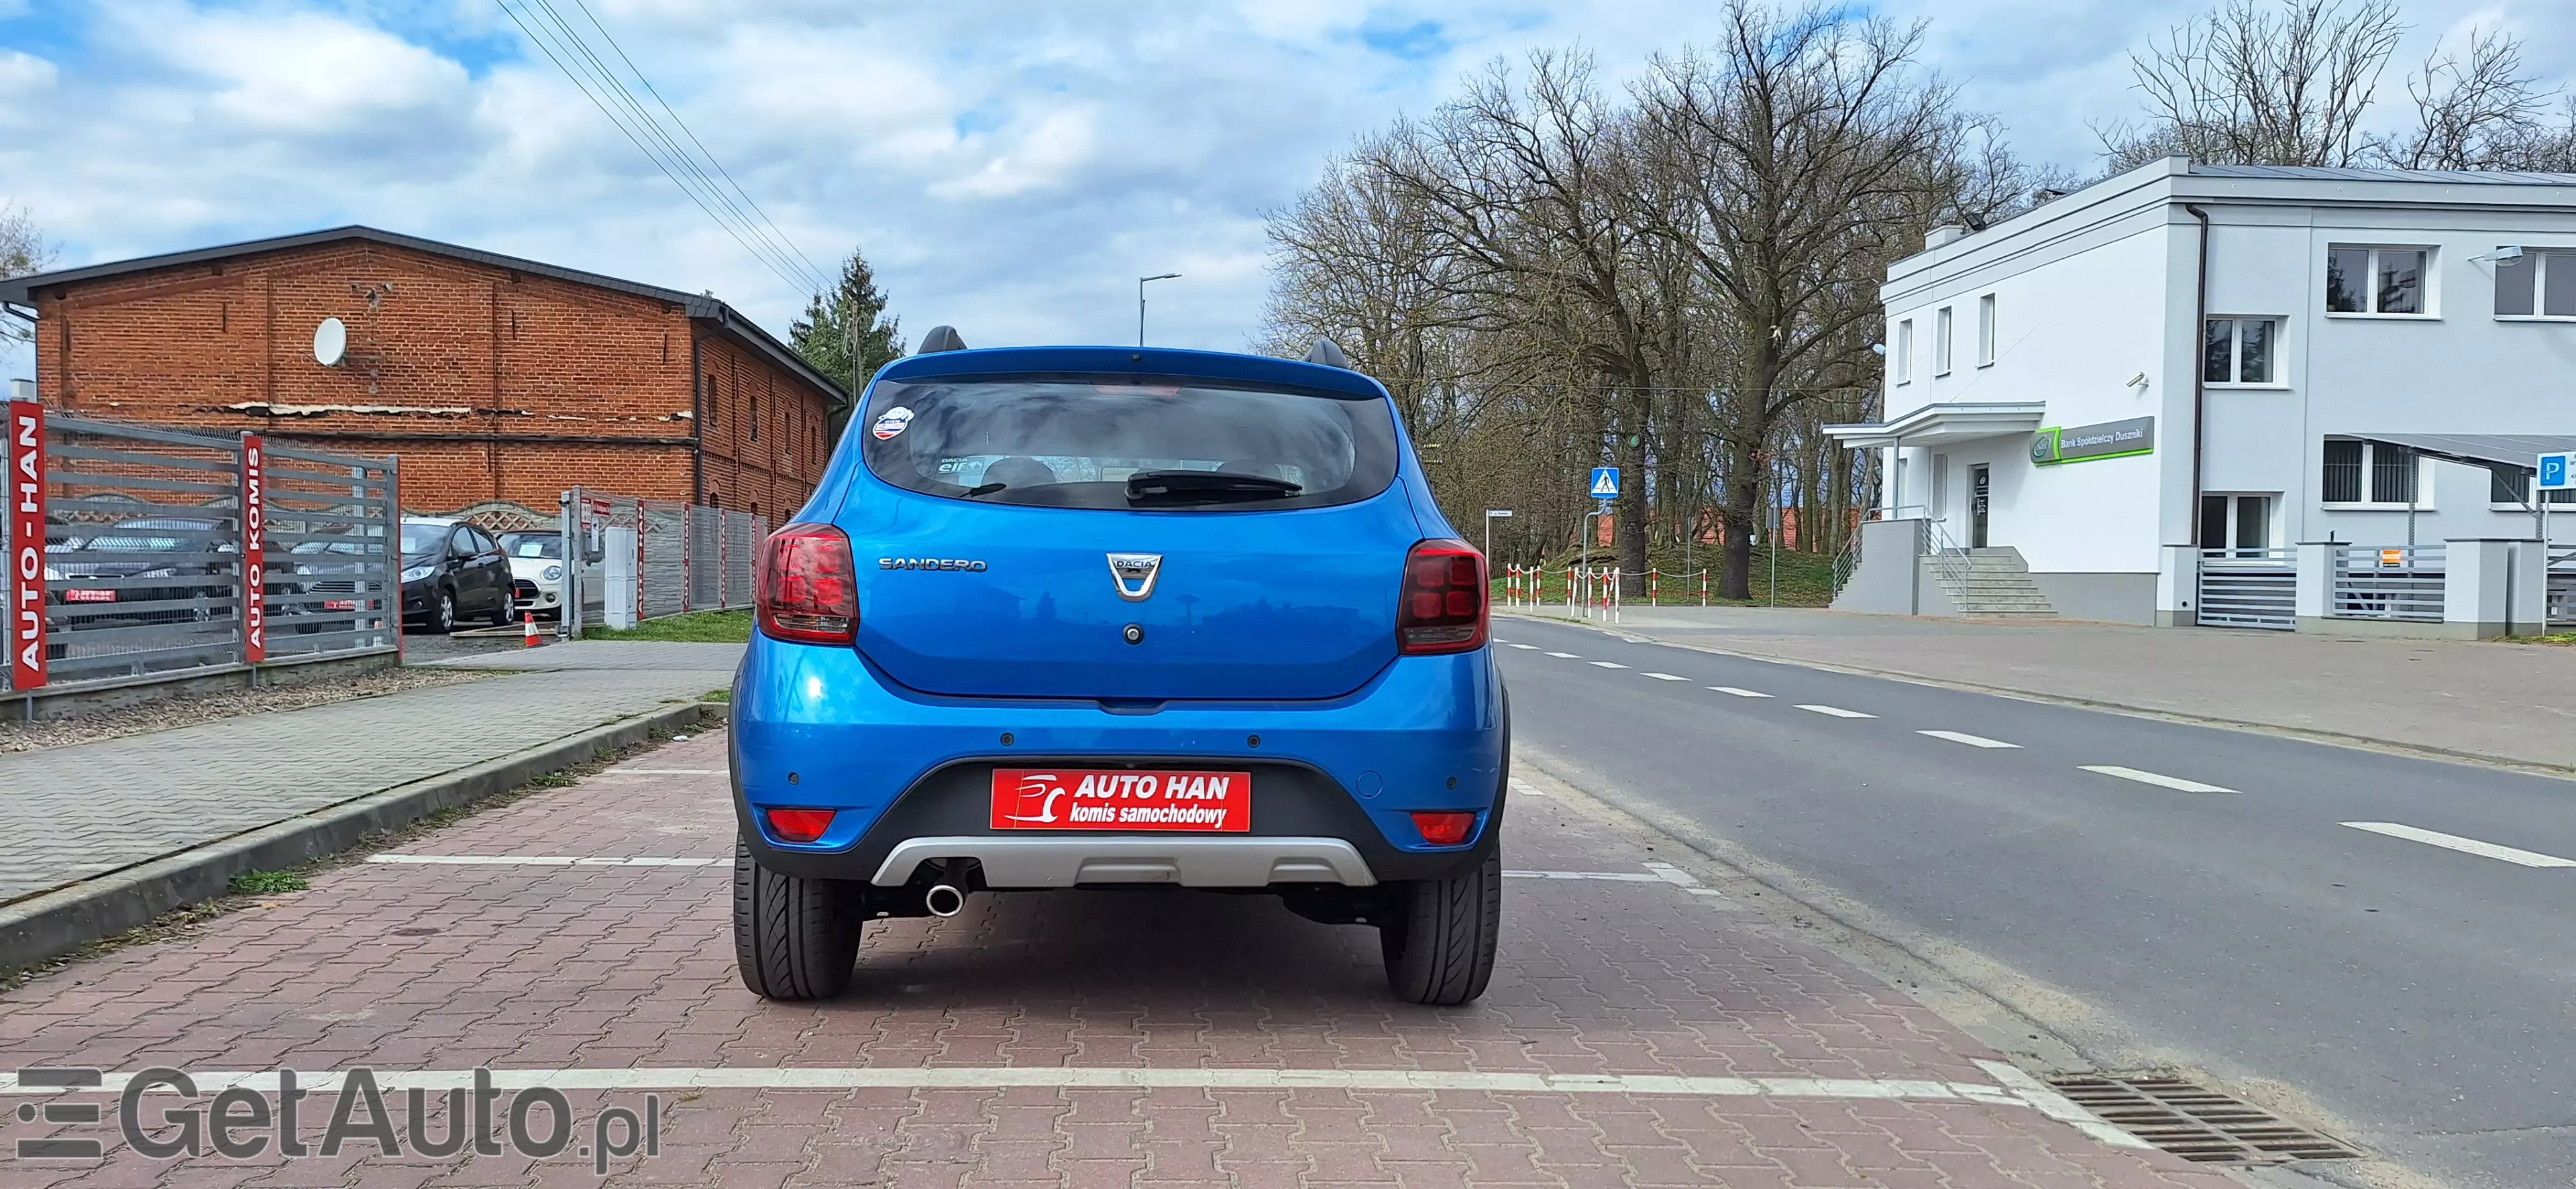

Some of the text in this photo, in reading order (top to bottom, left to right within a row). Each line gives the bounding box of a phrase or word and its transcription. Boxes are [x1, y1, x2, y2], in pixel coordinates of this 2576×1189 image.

[2061, 439, 2076, 449] Bank
[2076, 434, 2114, 447] Spółdzielczy
[2115, 428, 2143, 441] Duszniki
[2546, 462, 2560, 480] P
[248, 447, 262, 649] AUTO KOMIS
[879, 558, 987, 572] SANDERO
[1074, 775, 1230, 800] AUTO HAN
[1070, 802, 1227, 828] komis samochodowy
